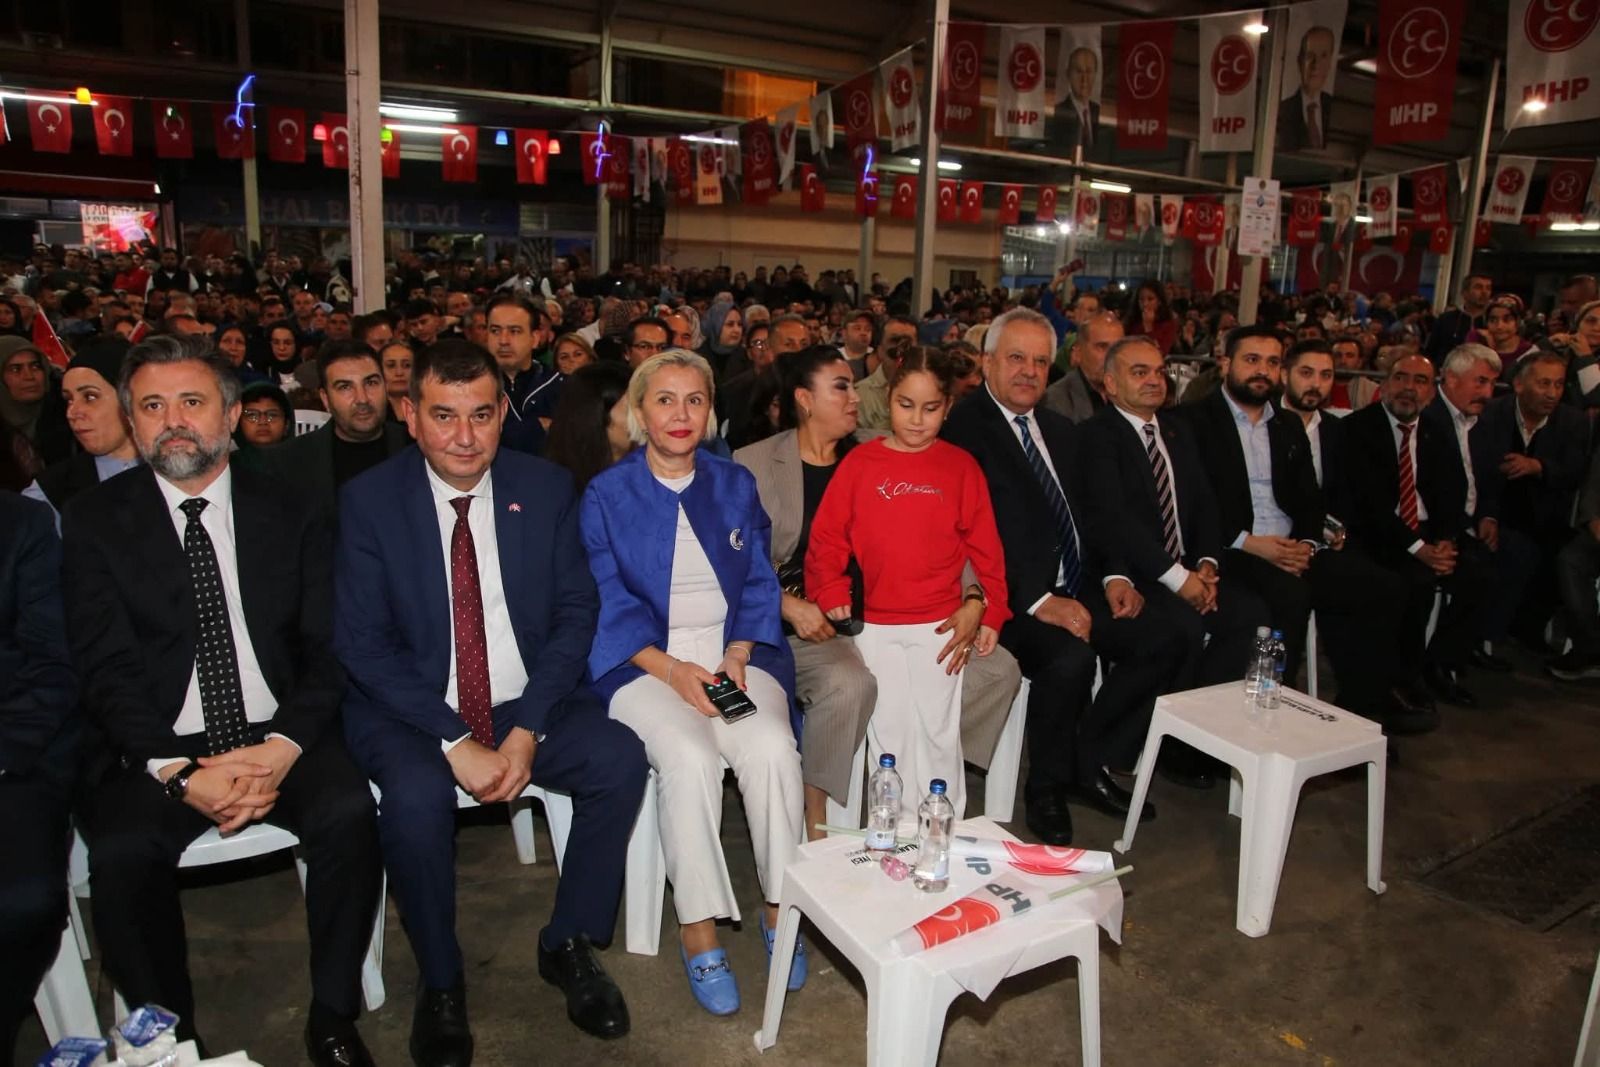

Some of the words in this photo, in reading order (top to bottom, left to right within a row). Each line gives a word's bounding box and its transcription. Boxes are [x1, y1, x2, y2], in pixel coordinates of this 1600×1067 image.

[1523, 77, 1590, 108] MHP
[1389, 102, 1438, 126] MHP
[985, 884, 1031, 912] HP
